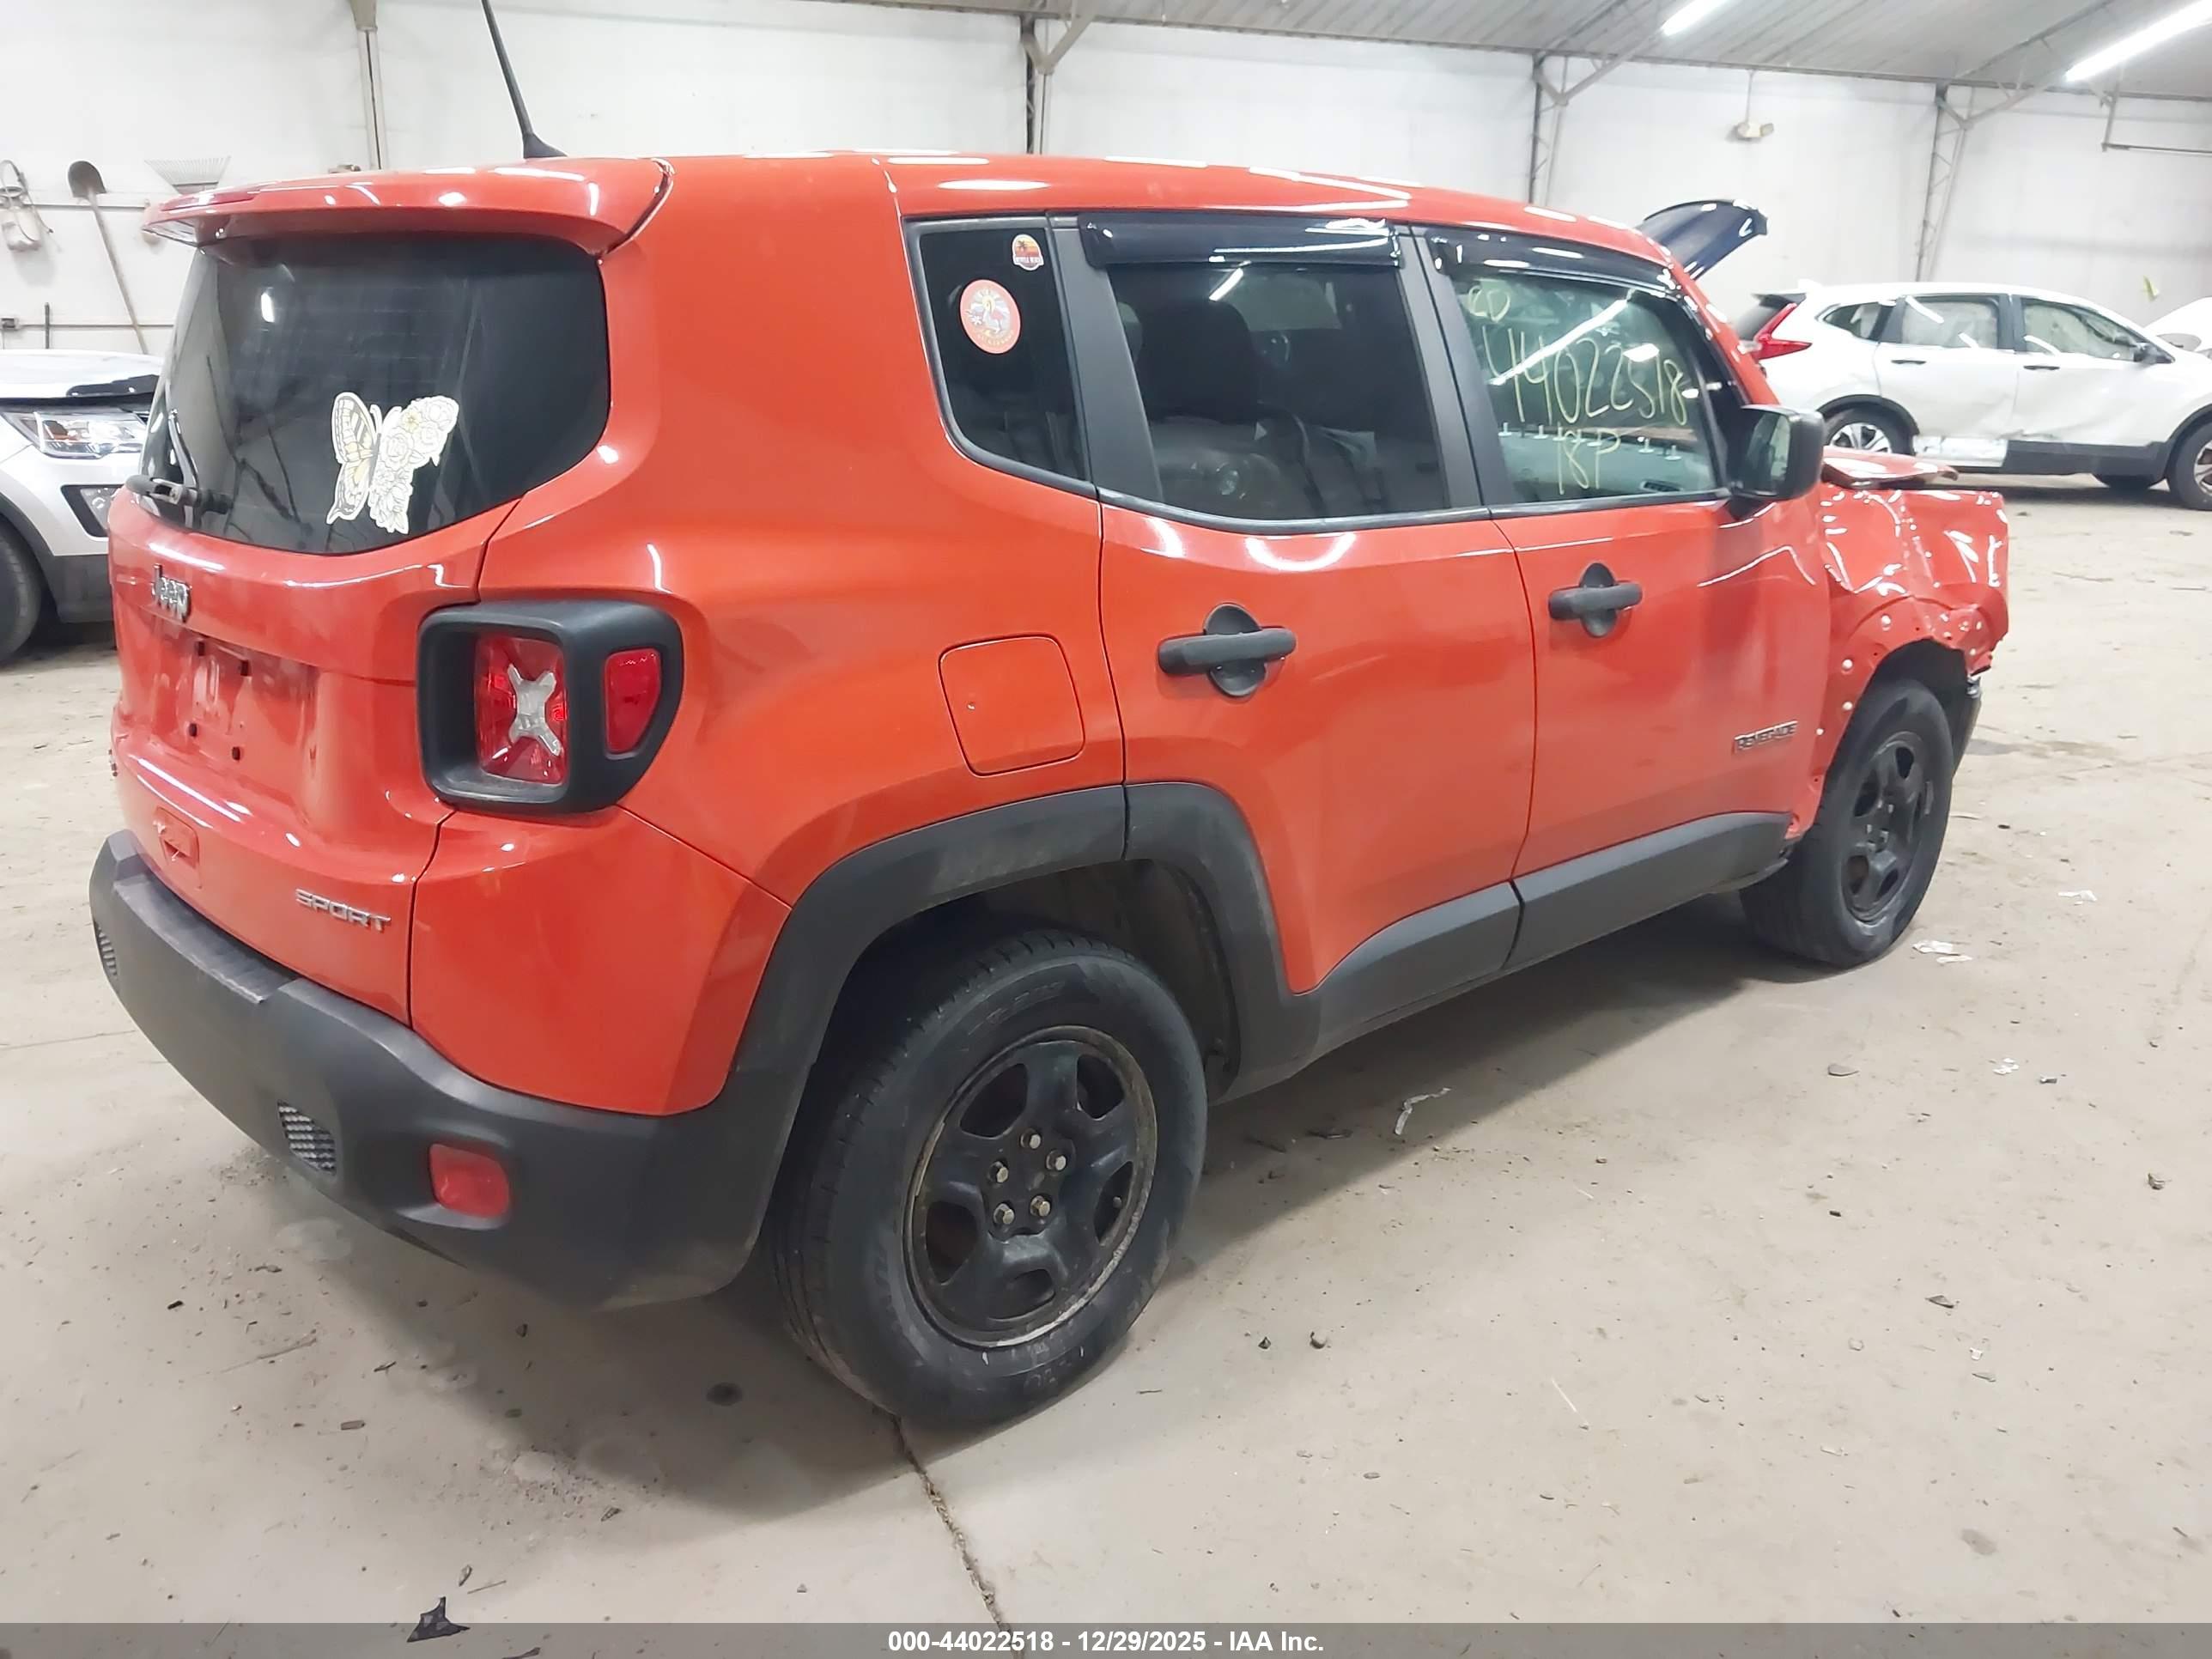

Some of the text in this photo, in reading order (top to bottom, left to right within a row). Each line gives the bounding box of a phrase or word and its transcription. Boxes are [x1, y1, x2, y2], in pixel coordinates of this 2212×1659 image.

[1481, 325, 1689, 427] 44022518
[152, 563, 191, 623] Jeep
[295, 888, 392, 932] SPORT
